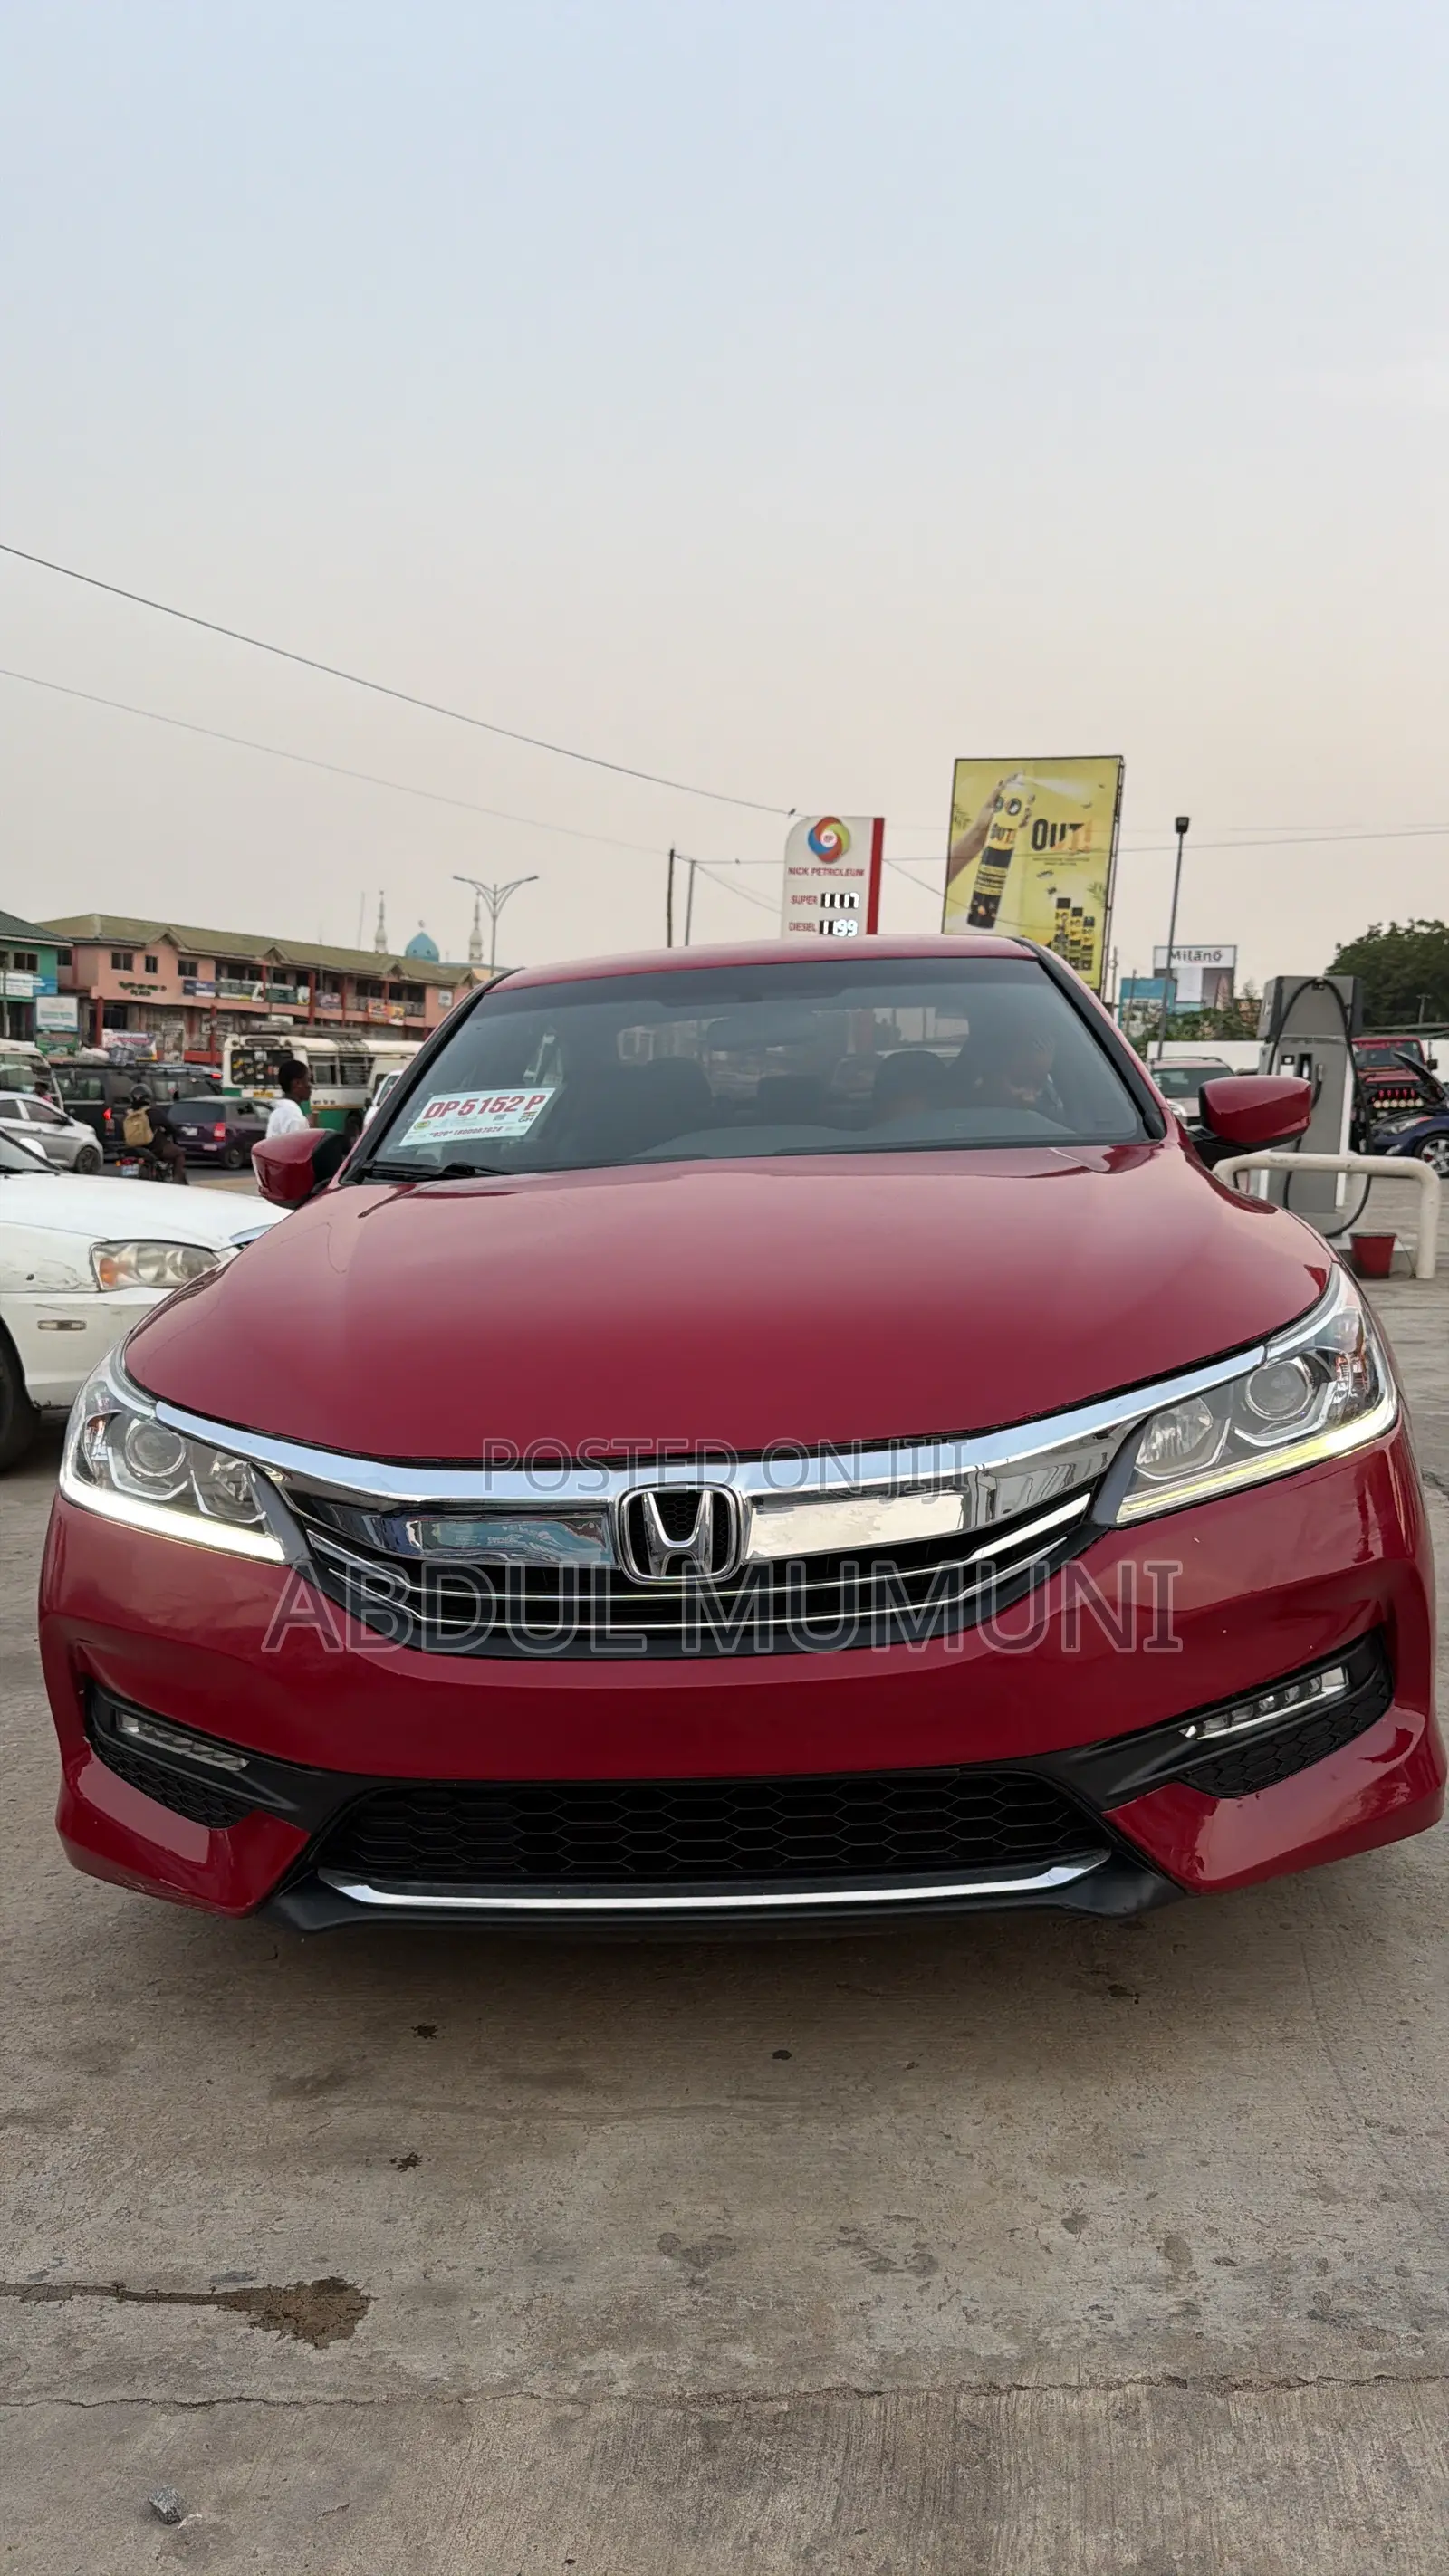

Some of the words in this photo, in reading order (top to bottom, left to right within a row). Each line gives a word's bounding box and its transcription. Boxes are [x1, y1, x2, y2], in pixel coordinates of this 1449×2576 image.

[811, 867, 865, 877] PETROLEUM
[790, 895, 818, 905] SUPER
[788, 921, 817, 932] DIESEL
